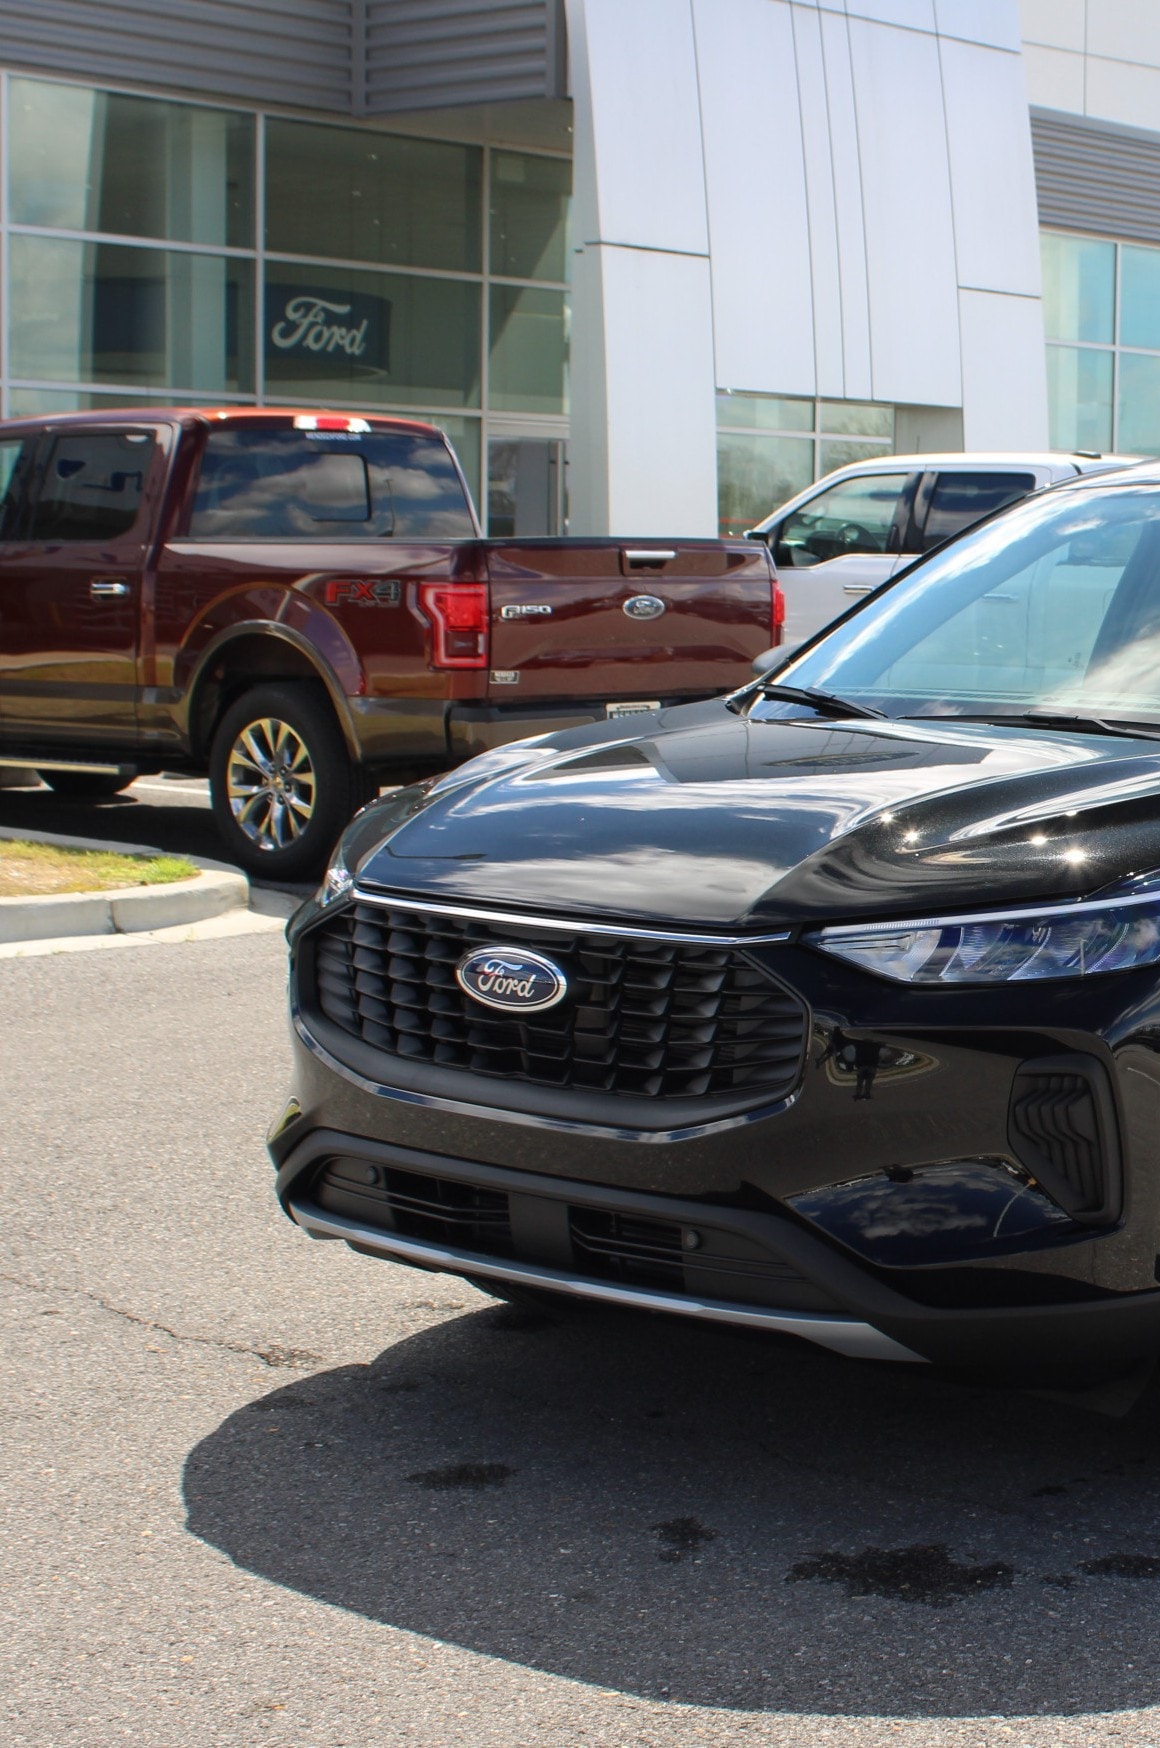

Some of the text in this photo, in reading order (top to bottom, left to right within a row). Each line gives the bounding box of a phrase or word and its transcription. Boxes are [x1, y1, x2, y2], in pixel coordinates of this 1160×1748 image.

[271, 295, 369, 357] Ford
[325, 580, 400, 606] FX4
[477, 958, 537, 998] Ford
